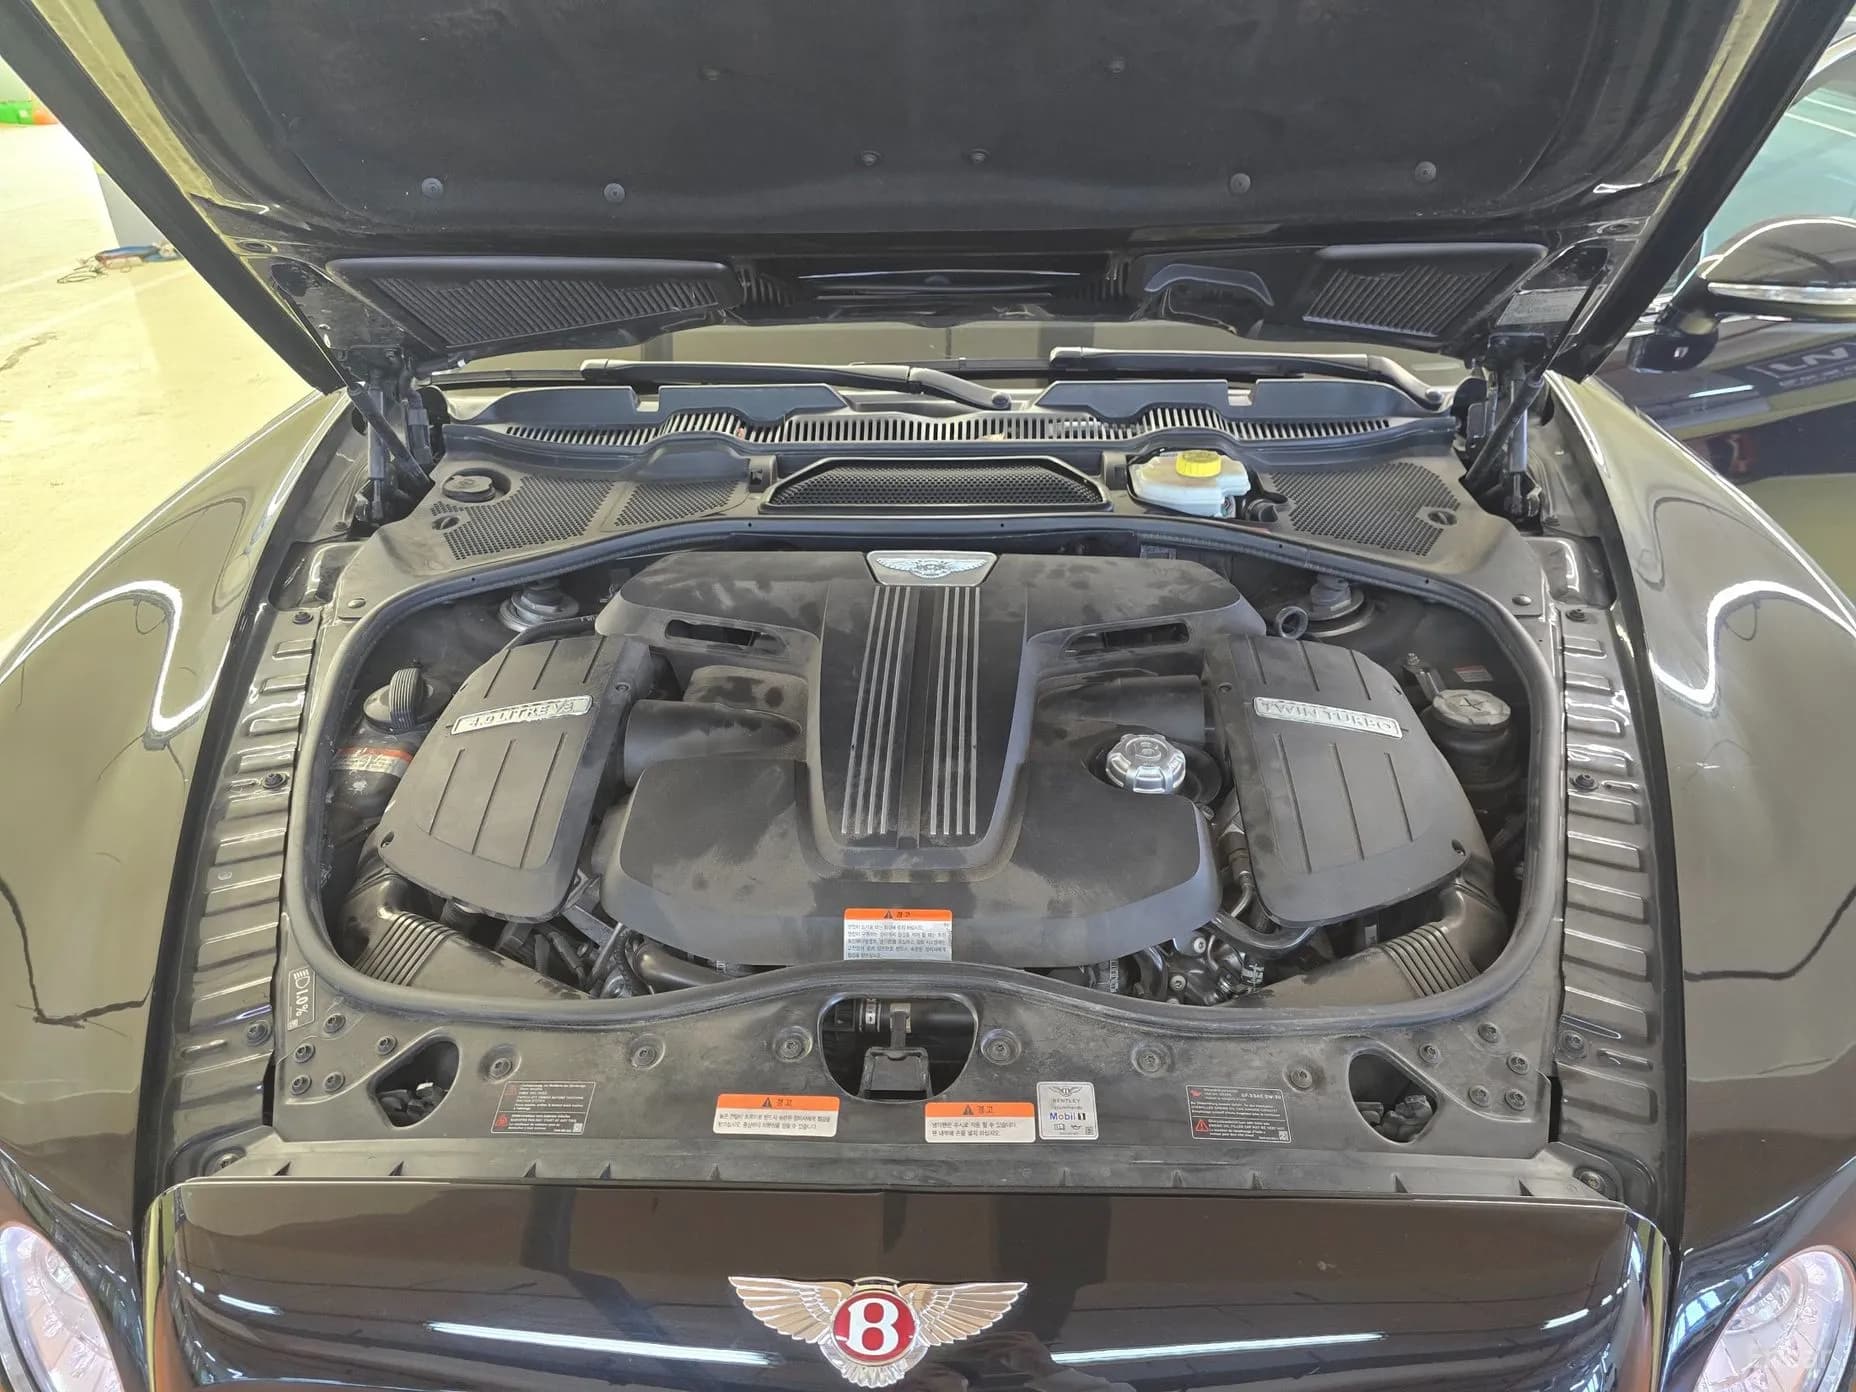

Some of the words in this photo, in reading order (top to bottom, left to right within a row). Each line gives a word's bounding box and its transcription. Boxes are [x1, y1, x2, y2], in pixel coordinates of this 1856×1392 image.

[1261, 702, 1317, 719] TWIN
[1323, 710, 1392, 730] TURBO
[1049, 1112, 1076, 1120] Mobil
[846, 1297, 899, 1356] B
